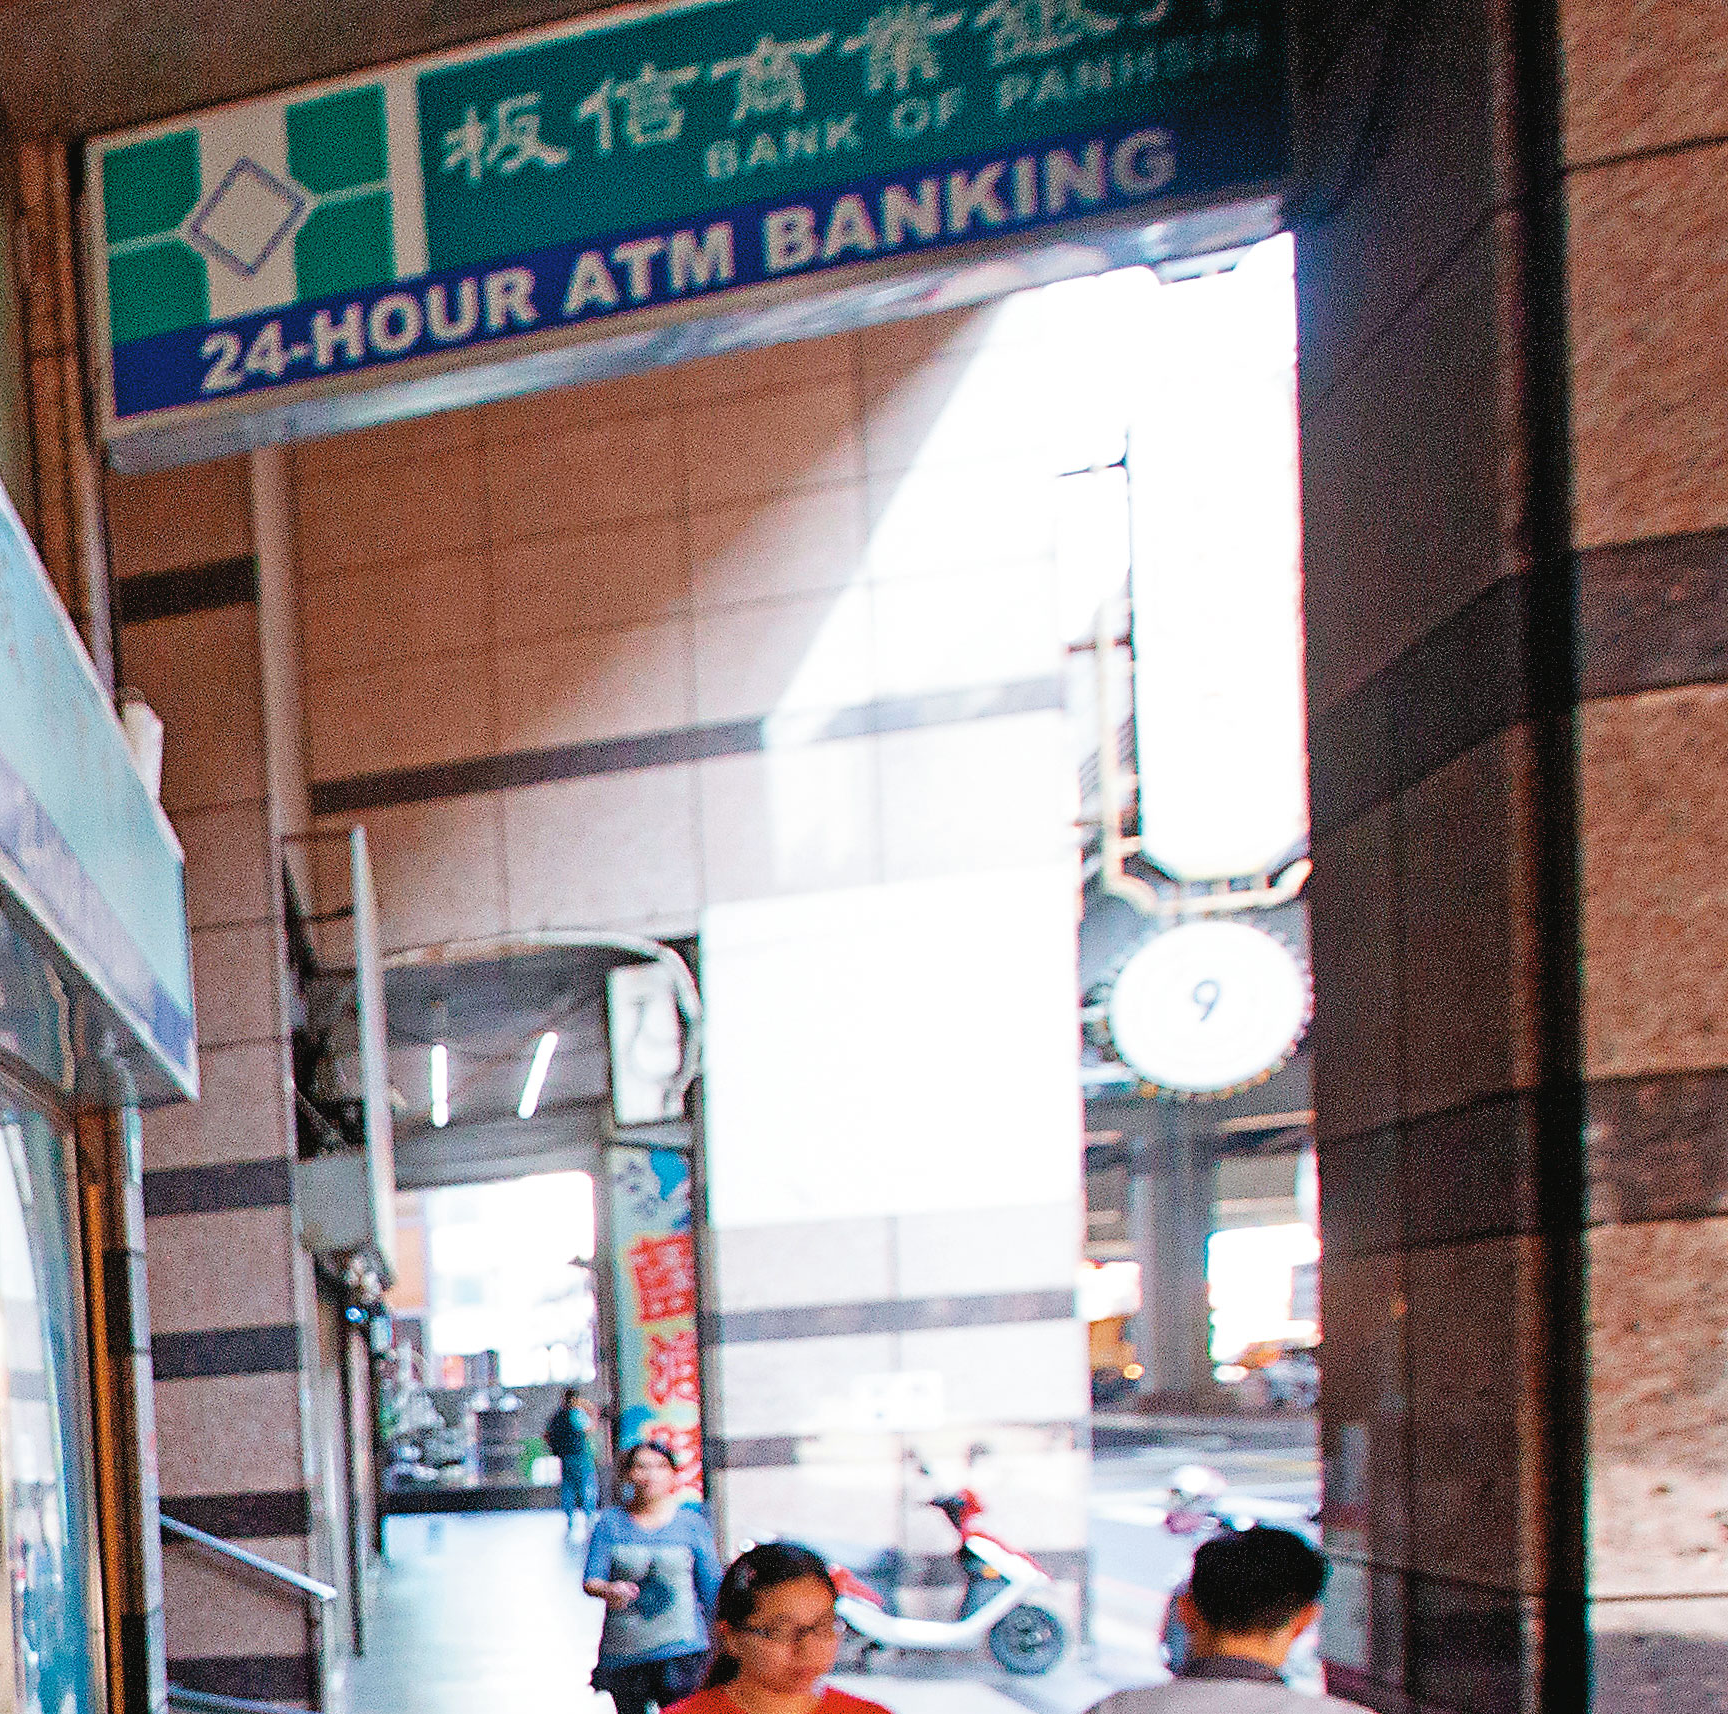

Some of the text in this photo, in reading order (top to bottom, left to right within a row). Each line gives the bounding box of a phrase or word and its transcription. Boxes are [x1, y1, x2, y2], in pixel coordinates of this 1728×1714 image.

[444, 0, 1225, 182] 板信商業銀
[706, 111, 862, 181] BANK
[891, 87, 963, 140] OF
[199, 126, 1177, 395] 24-HOUR ATM BANKING
